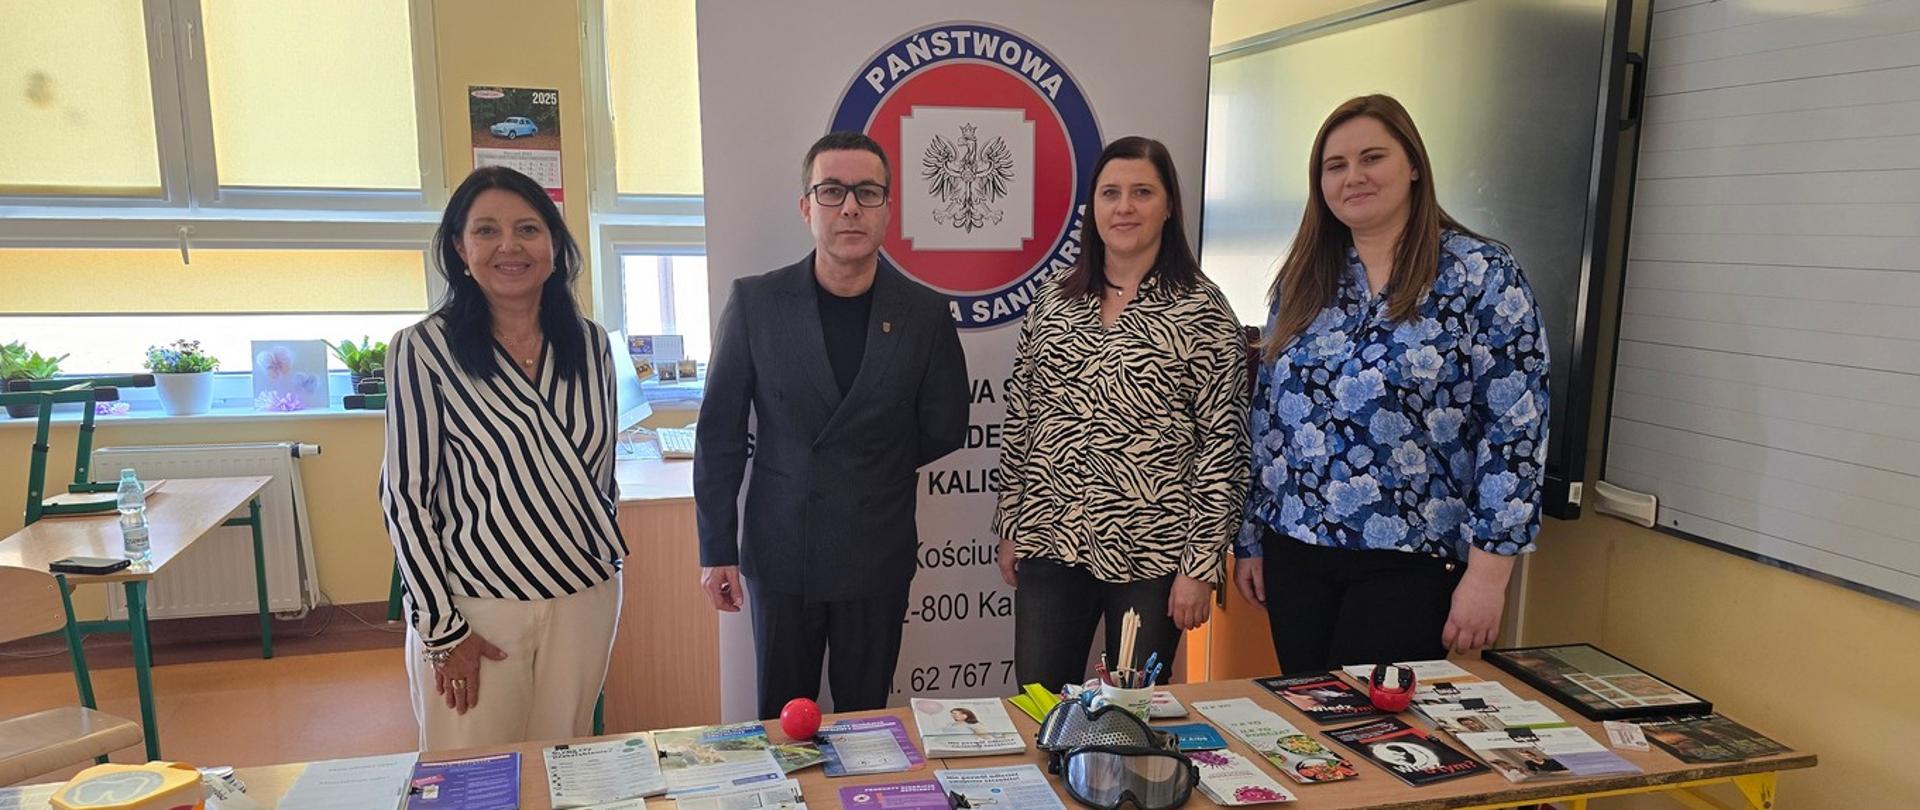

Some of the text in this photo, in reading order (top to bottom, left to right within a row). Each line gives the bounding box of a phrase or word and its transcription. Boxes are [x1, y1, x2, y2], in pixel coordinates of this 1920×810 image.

[865, 31, 1063, 100] PAŃSTWOWA
[532, 92, 557, 105] 2025
[949, 301, 963, 322] A
[967, 424, 1001, 449] DE
[928, 468, 1001, 495] KALIS
[904, 590, 1012, 624] -800 Ka
[911, 666, 940, 692] 62
[949, 662, 993, 689] 767
[1001, 660, 1014, 685] 7
